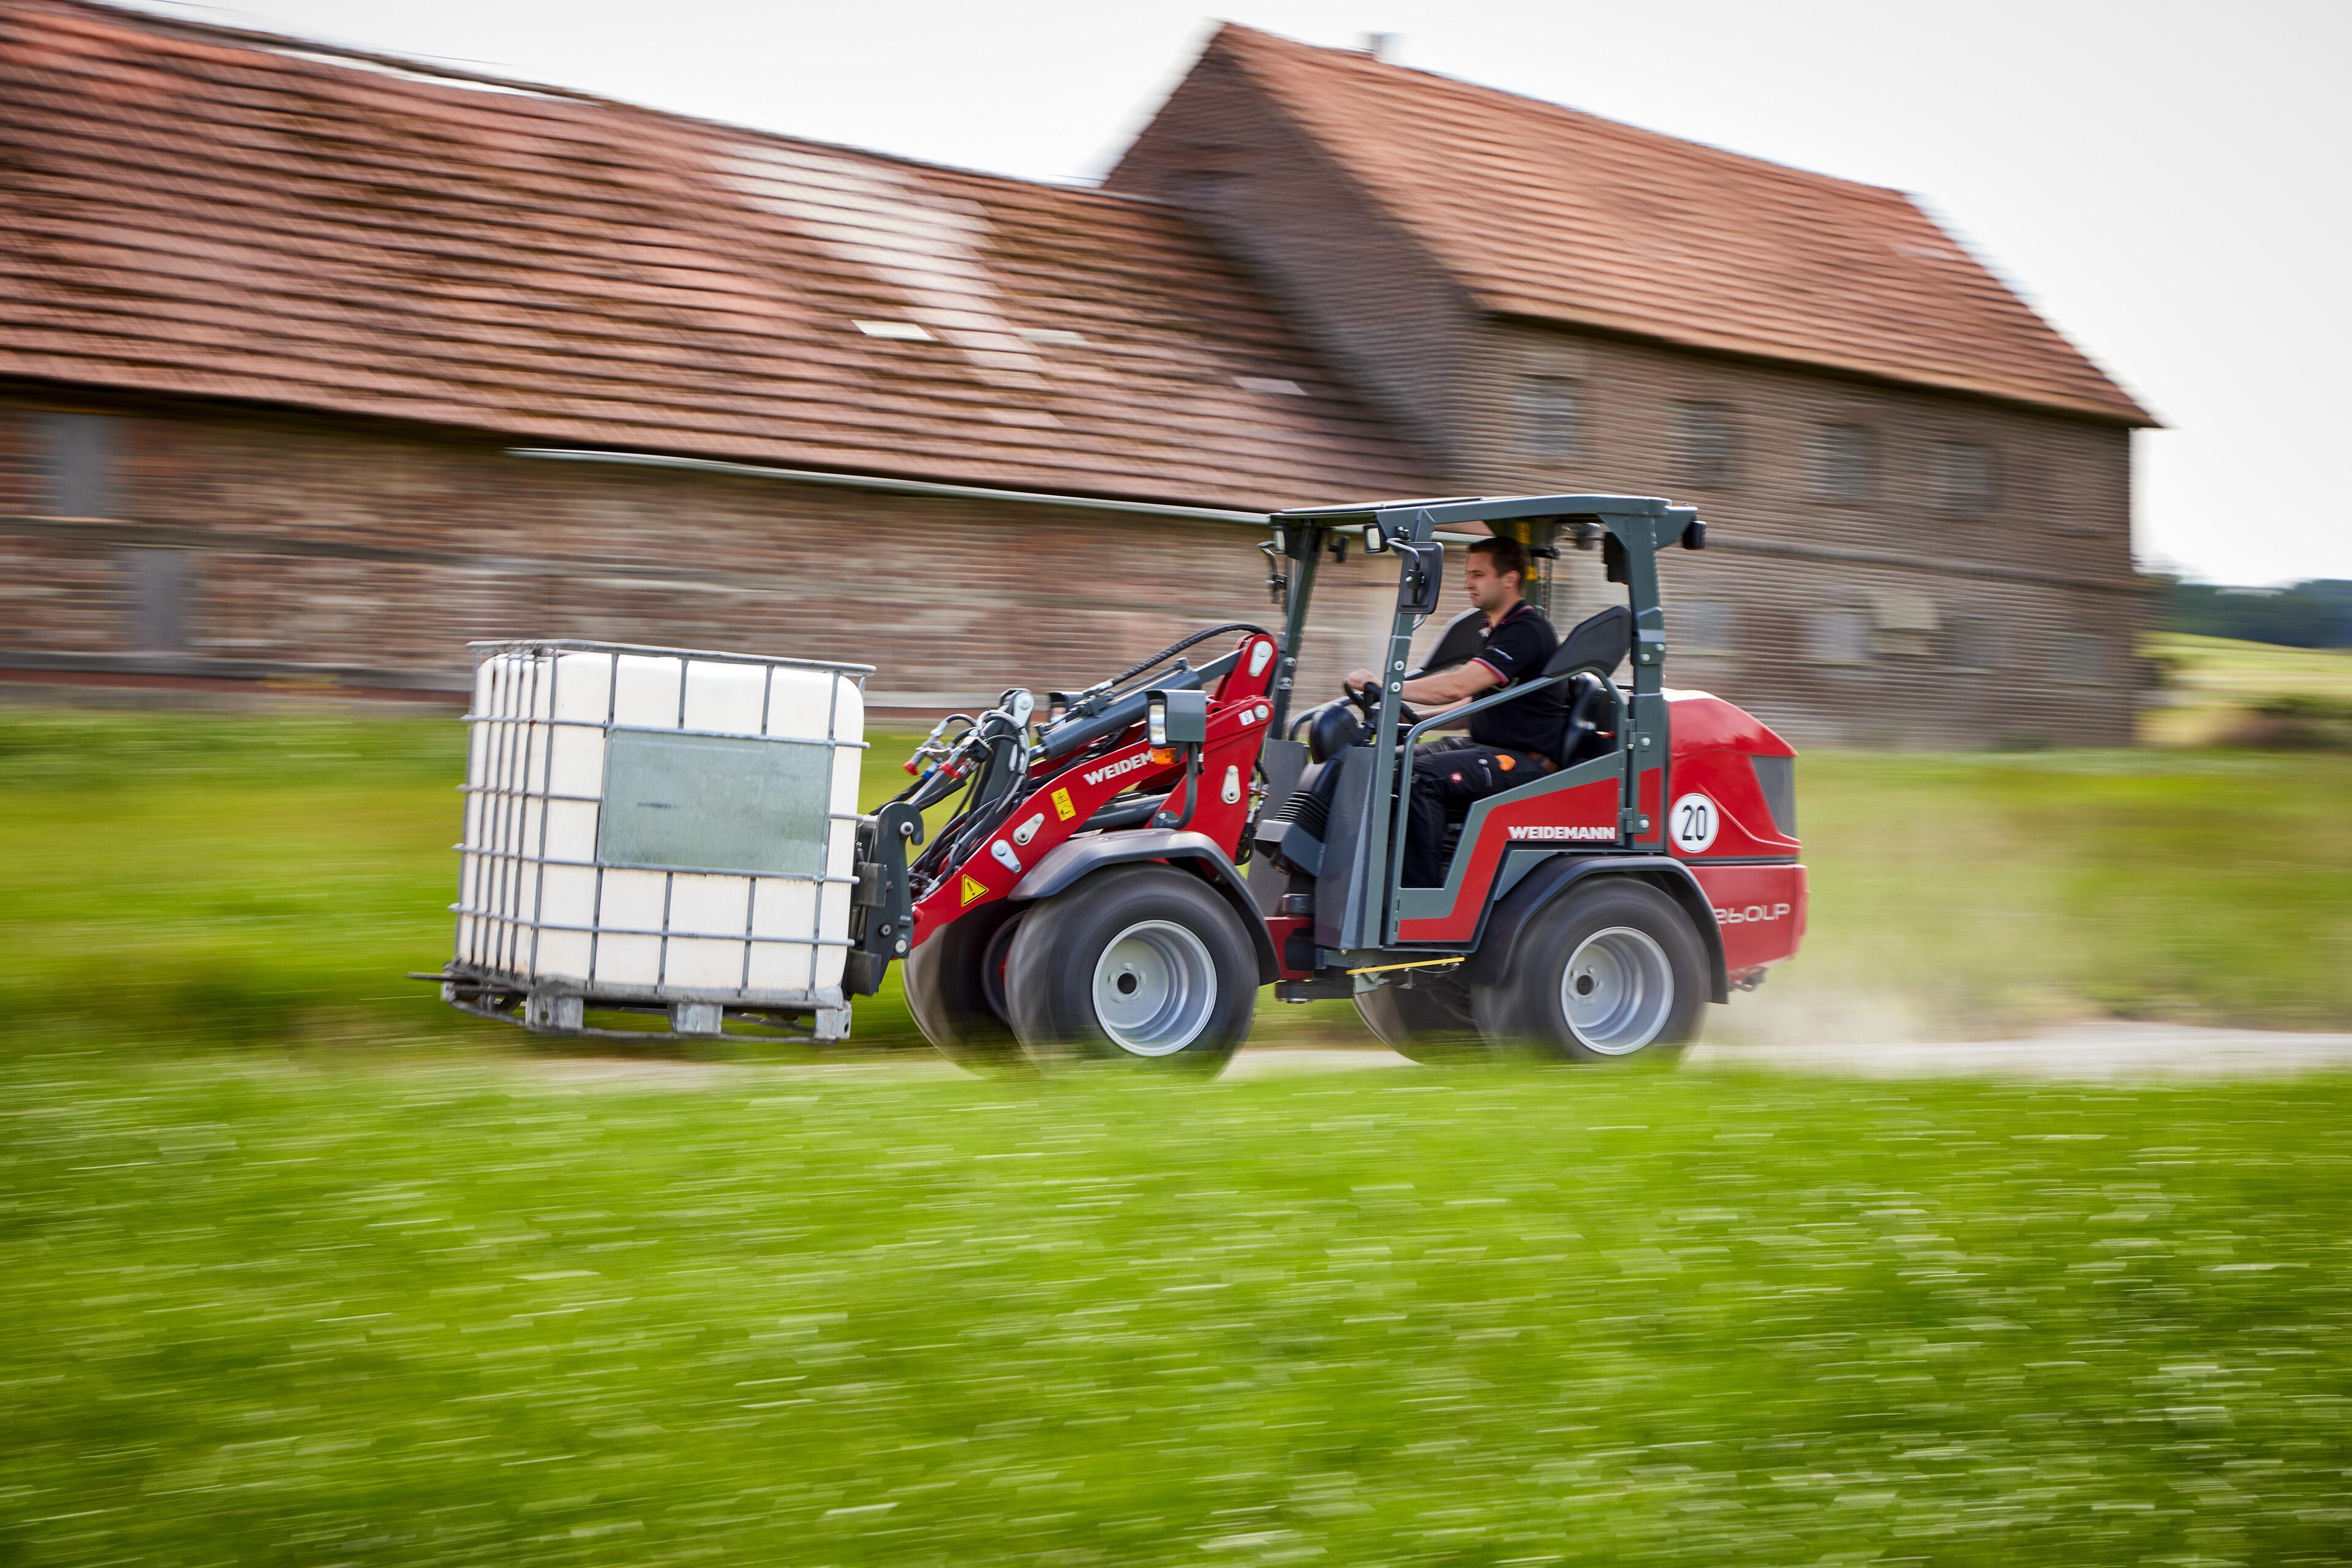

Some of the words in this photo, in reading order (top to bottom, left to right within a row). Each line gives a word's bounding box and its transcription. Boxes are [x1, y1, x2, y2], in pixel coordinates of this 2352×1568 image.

[1083, 750, 1155, 785] WEIDEM
[1507, 826, 1616, 839] WEIDEMANN
[1683, 805, 1706, 841] 20
